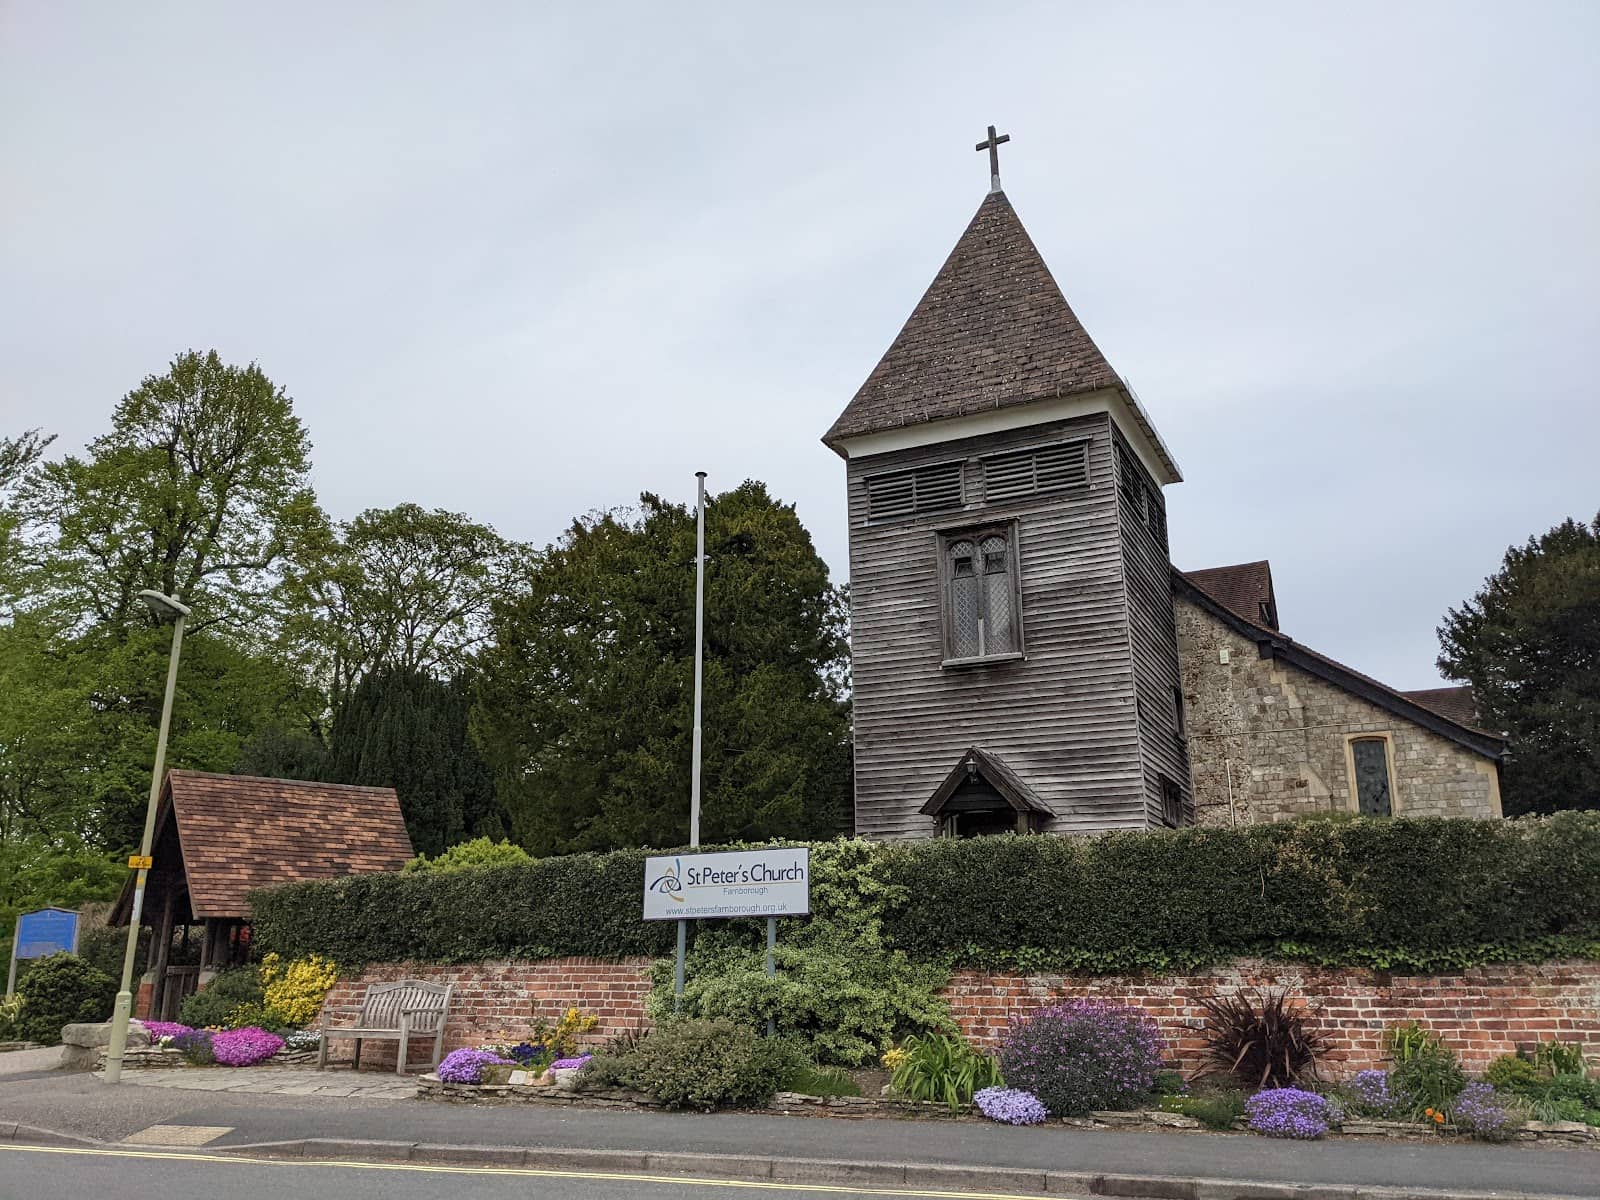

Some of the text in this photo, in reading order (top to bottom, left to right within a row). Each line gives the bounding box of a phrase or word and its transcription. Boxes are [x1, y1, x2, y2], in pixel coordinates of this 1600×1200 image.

[687, 861, 804, 886] St Peter's Church
[723, 886, 768, 896] Farnborough
